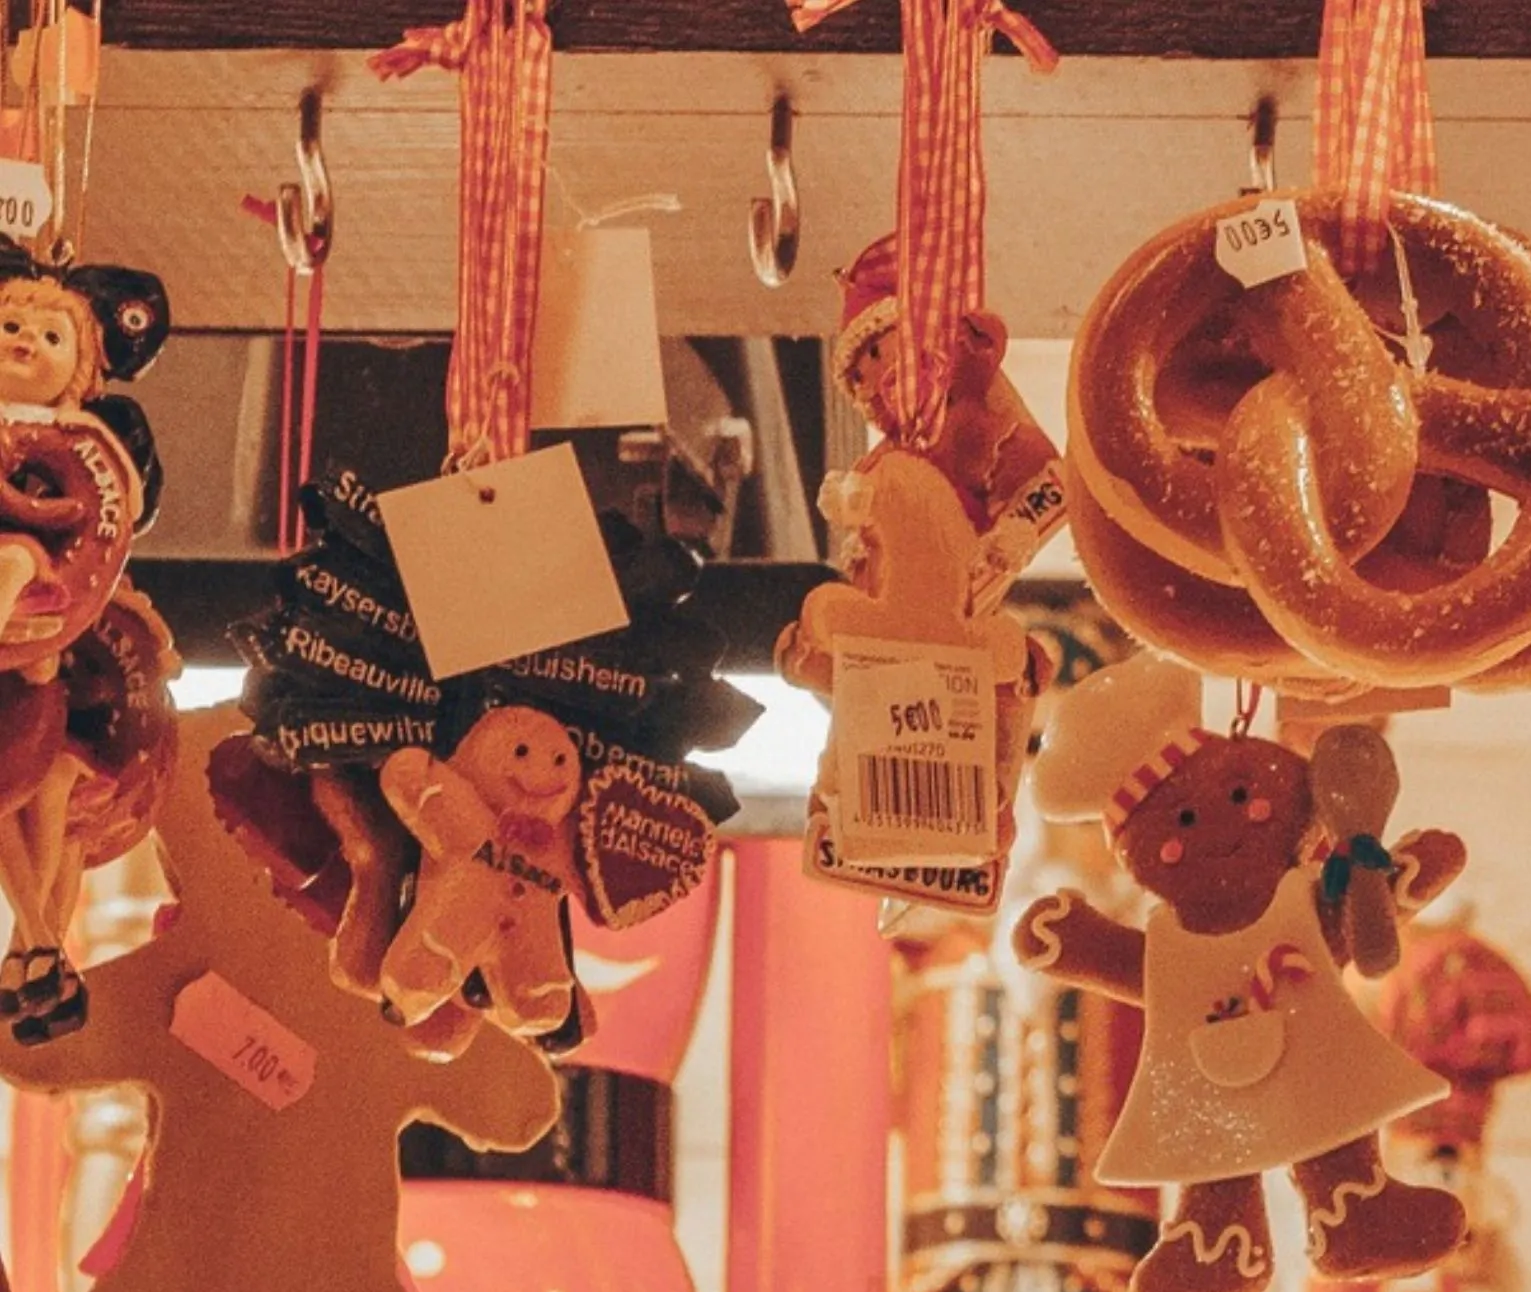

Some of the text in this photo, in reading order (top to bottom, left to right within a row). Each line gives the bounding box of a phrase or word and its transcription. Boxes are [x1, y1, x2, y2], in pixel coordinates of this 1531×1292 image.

[0, 197, 34, 228] 00
[73, 440, 121, 540] ALSACE
[500, 652, 647, 699] guisheim
